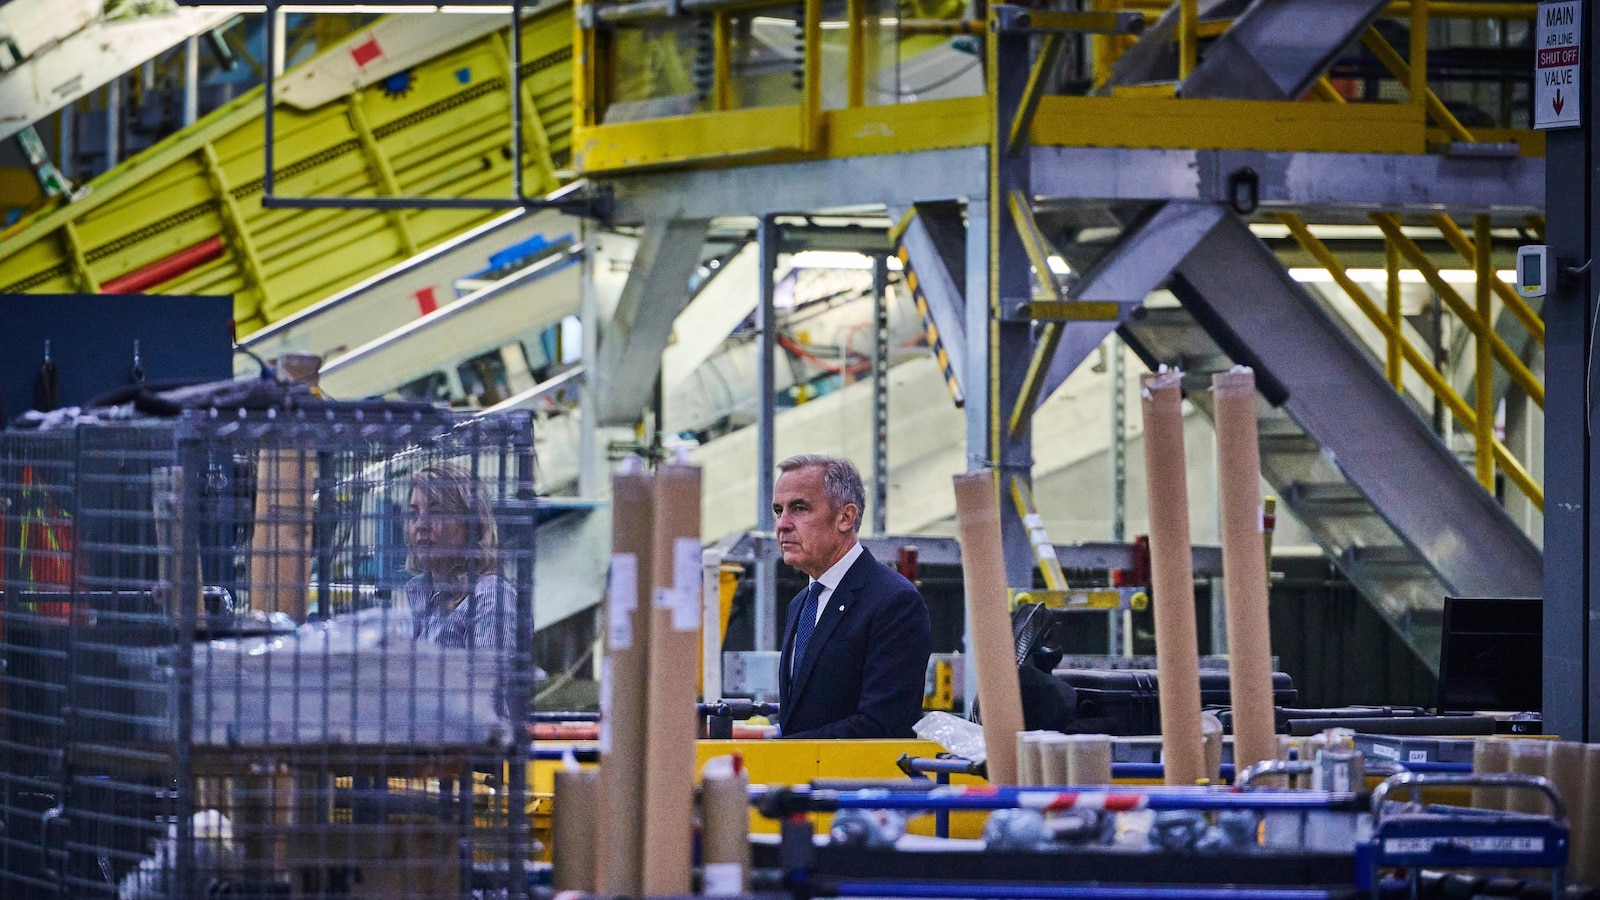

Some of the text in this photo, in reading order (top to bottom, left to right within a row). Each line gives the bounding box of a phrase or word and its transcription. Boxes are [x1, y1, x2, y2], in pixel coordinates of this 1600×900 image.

[1546, 6, 1574, 27] MAIN
[1546, 32, 1573, 46] AIR LINE
[1540, 49, 1577, 65] SHUT OFF
[1545, 69, 1573, 87] VALVE
